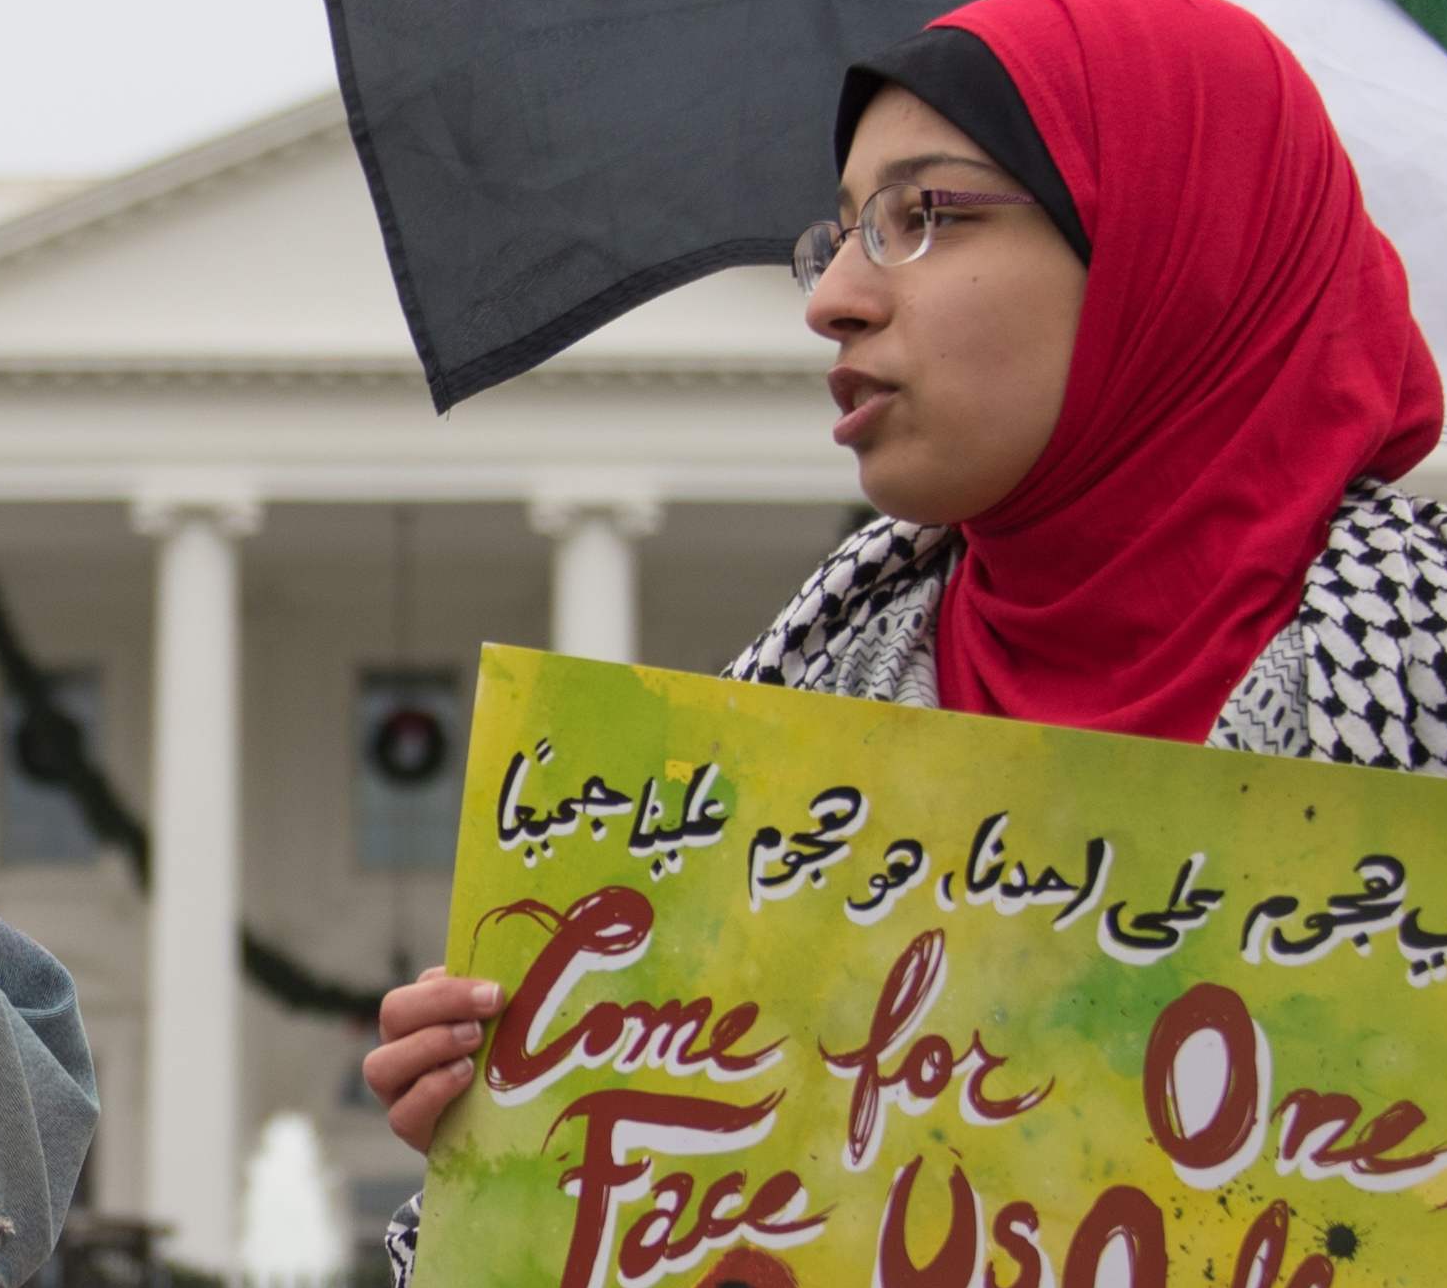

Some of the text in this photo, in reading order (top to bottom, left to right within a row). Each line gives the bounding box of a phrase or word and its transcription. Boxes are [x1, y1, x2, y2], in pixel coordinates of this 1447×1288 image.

[628, 762, 730, 878] علينا
[748, 785, 865, 911] هجوم
[845, 838, 927, 918] هو
[1240, 853, 1406, 958] هجوم
[472, 886, 790, 1097] Come
[818, 927, 1056, 1167] for
